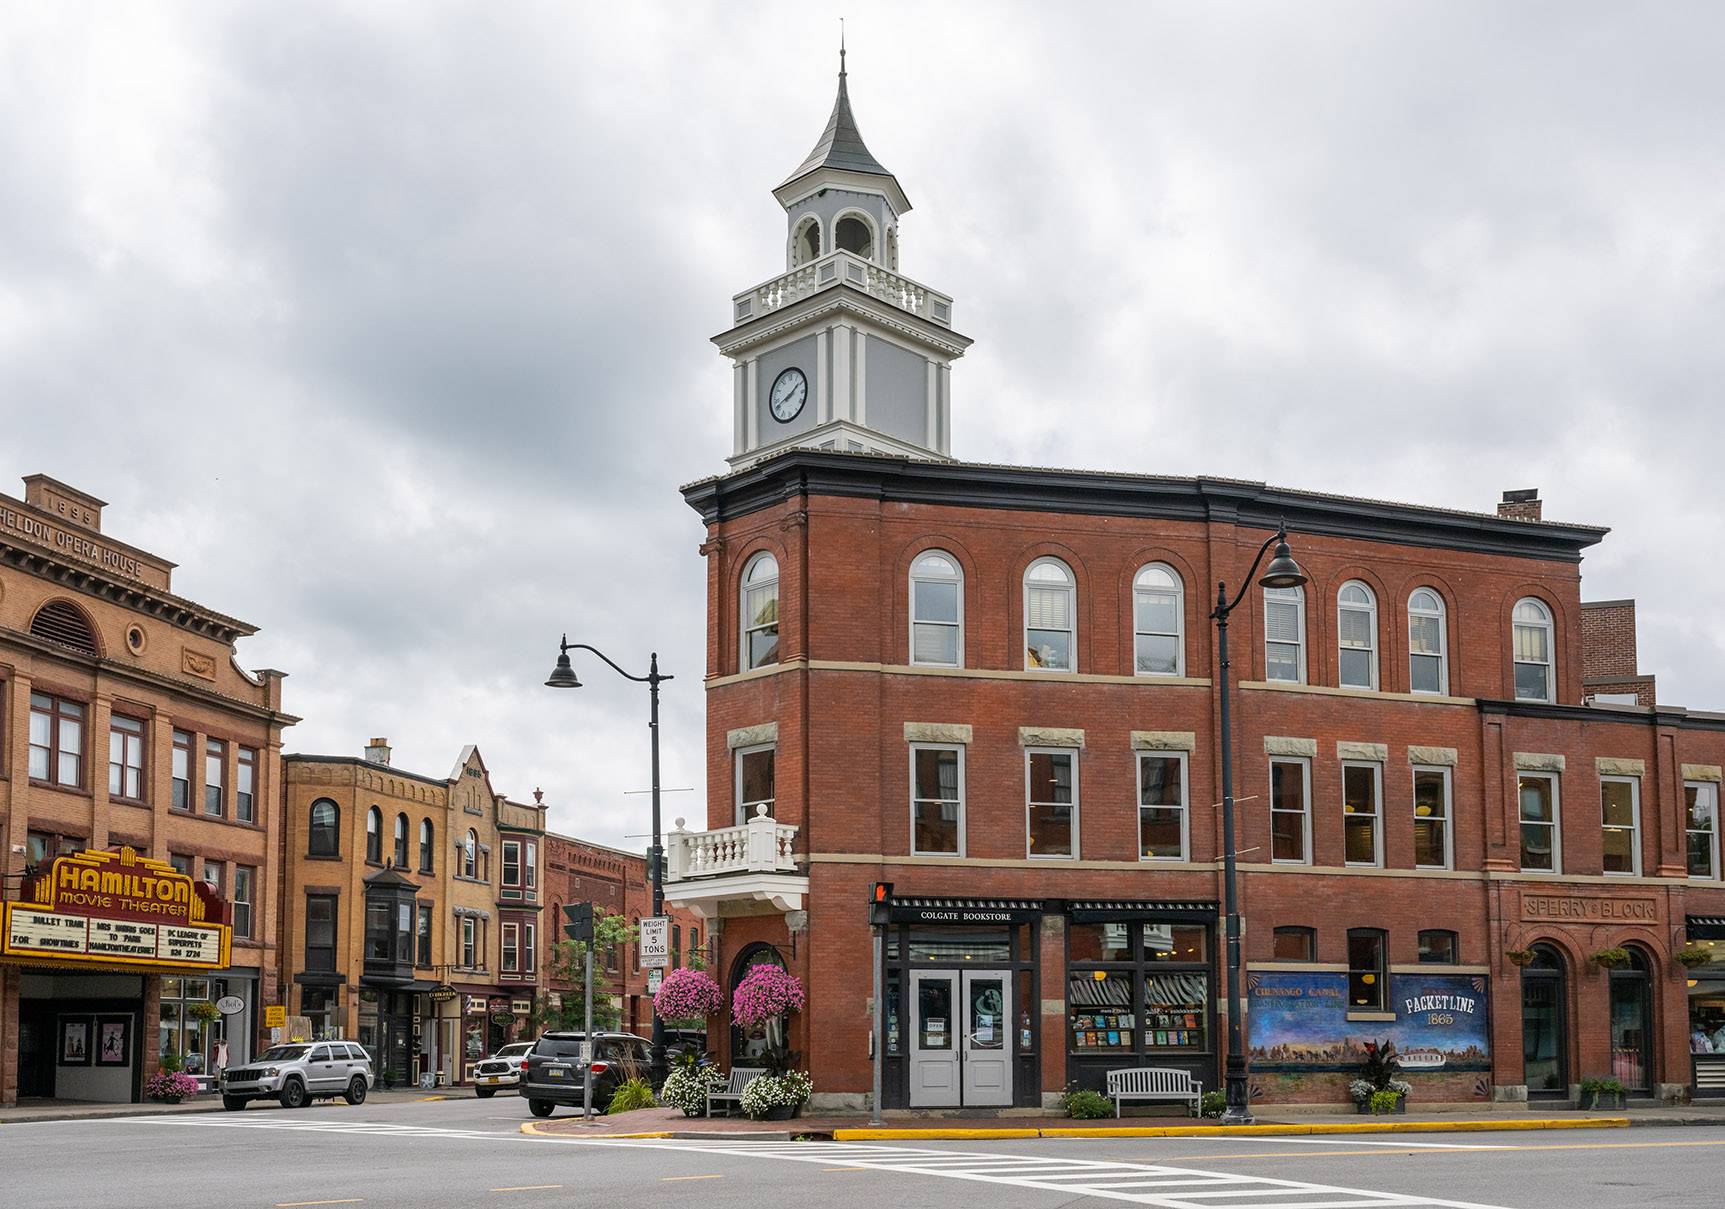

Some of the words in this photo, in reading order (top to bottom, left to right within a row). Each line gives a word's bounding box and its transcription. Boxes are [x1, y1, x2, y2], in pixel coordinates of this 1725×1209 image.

[48, 496, 92, 524] 1895
[56, 530, 98, 560] OPERA
[103, 547, 143, 577] HOUSE
[60, 865, 189, 904] HAMILTON
[60, 891, 113, 908] MOVIE
[118, 898, 188, 917] THEATER
[1526, 899, 1587, 917] SPERRY
[1600, 901, 1653, 918] BLOCK
[33, 915, 61, 927] BULLET
[920, 911, 959, 920] COLGATE
[963, 912, 1012, 921] BOOKSTORE
[643, 920, 665, 928] WEIGHT
[109, 933, 118, 941] TO
[139, 926, 155, 936] GOES
[200, 932, 209, 940] OF
[13, 935, 29, 944] FOR
[40, 937, 79, 949] SHOWTIMES
[168, 938, 202, 949] SUPERPETS
[651, 936, 657, 944] 5
[644, 945, 665, 953] TONS
[1405, 994, 1448, 1014] PACKET
[1449, 995, 1475, 1014] LINE
[1427, 1013, 1454, 1025] 1865
